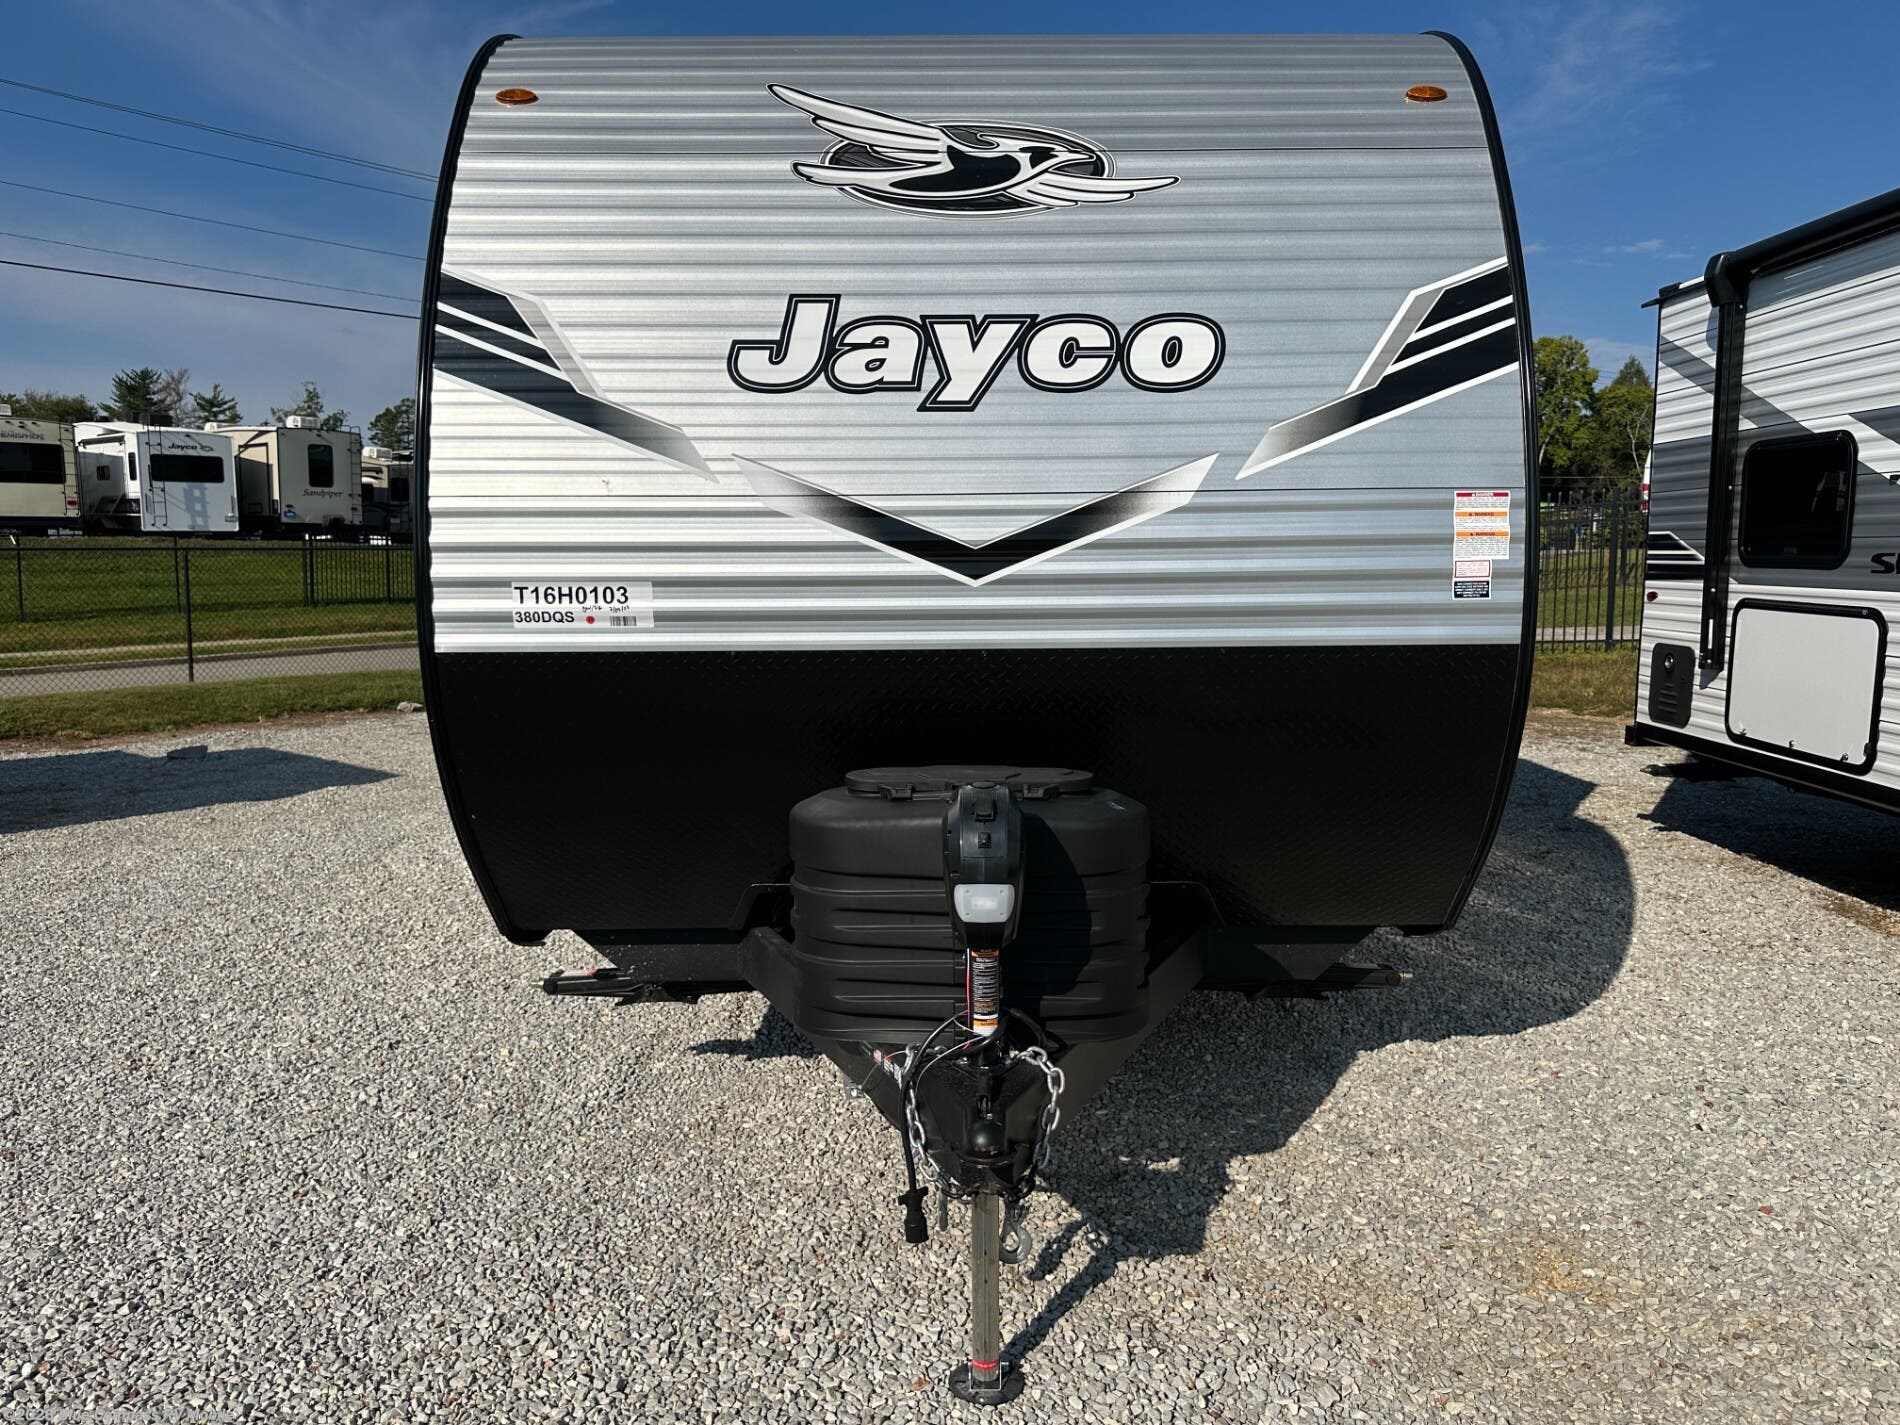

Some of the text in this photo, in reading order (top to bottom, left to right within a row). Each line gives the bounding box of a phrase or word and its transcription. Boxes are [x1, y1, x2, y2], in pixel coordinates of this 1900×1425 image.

[727, 294, 1226, 412] Jayco
[168, 442, 198, 451] Jayco
[302, 488, 344, 500] Sandpiper
[1870, 553, 1900, 575] S
[514, 586, 629, 604] T16H0103
[515, 611, 575, 624] 380DQS
